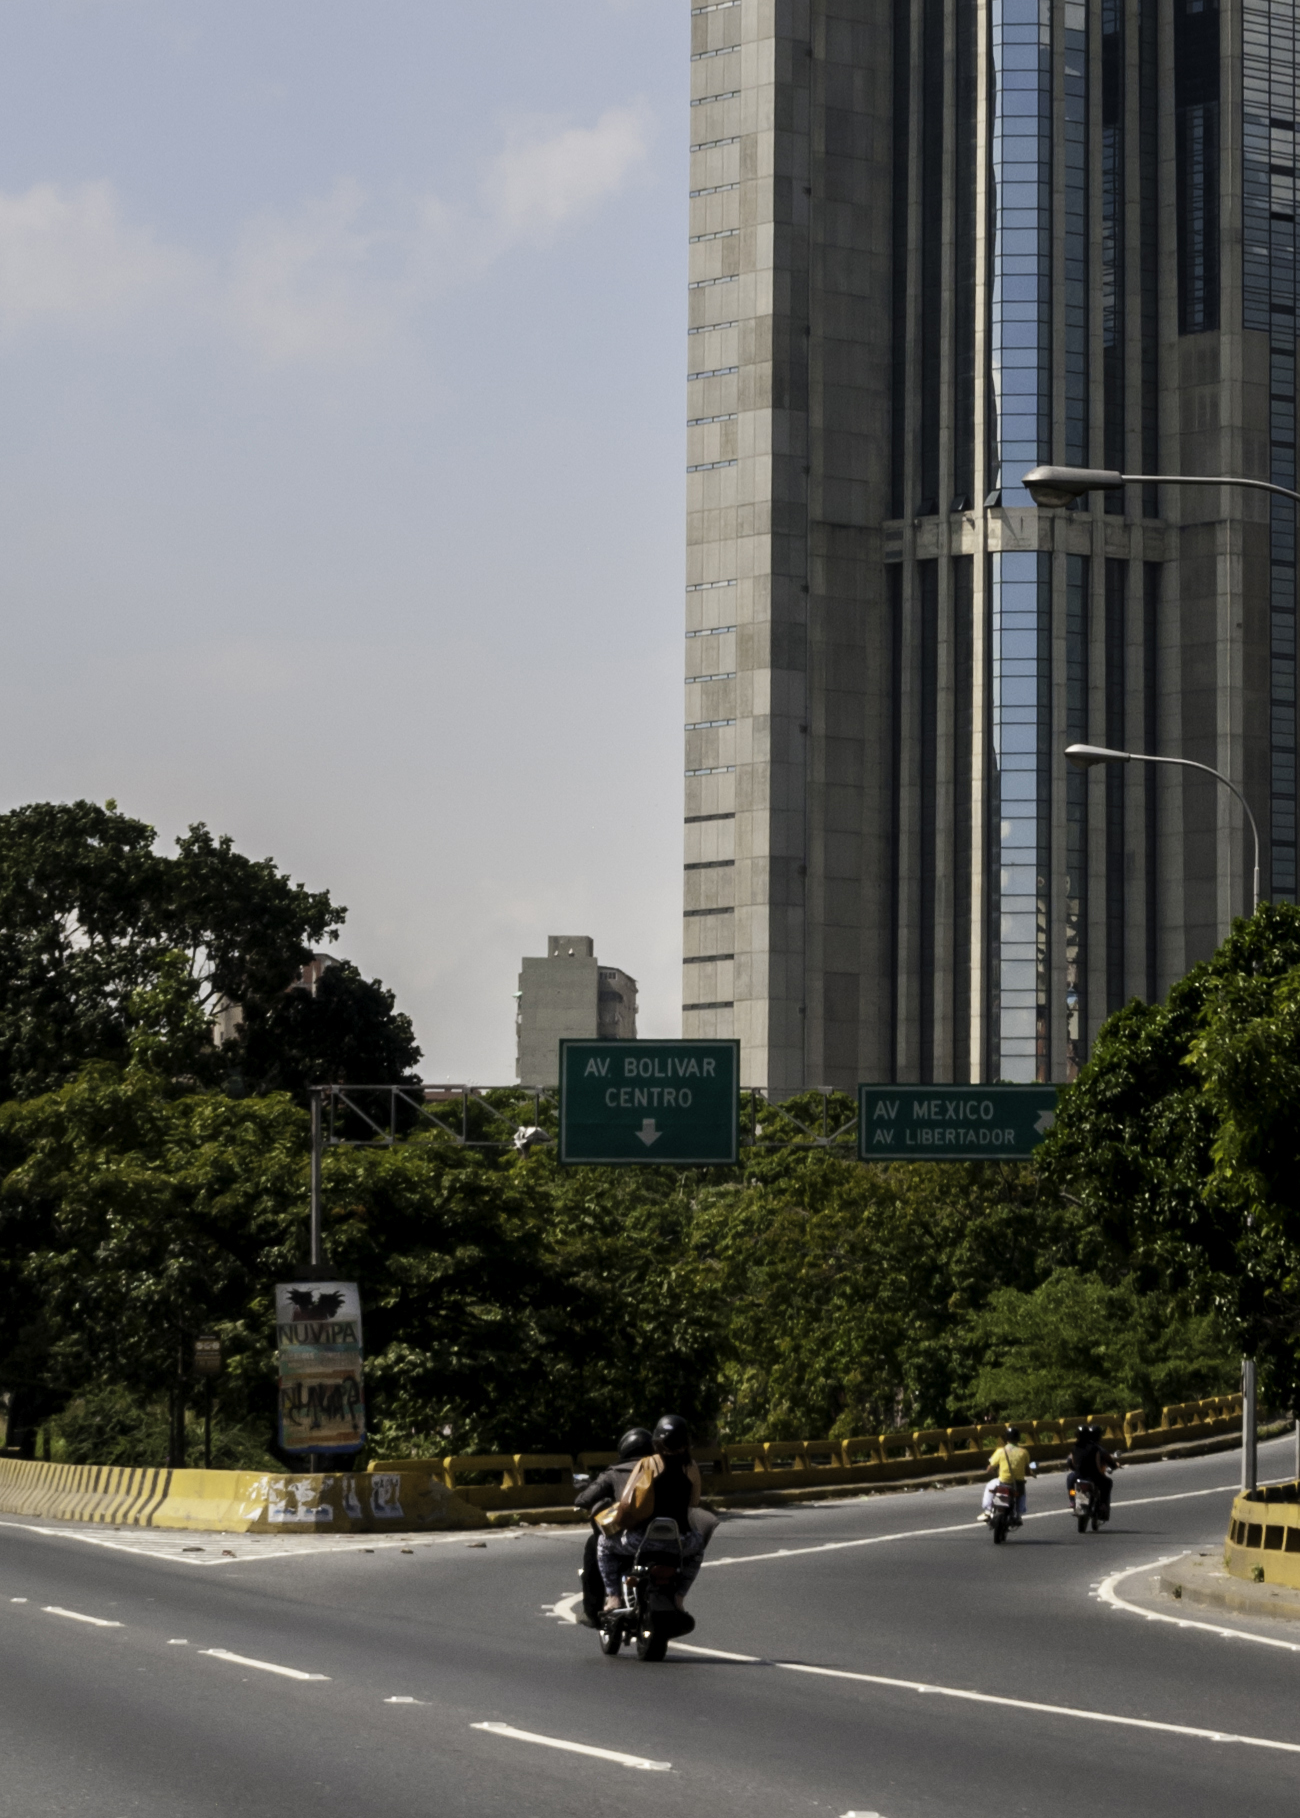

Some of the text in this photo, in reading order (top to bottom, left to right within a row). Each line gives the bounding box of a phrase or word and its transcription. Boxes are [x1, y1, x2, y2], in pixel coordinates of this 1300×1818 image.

[584, 1057, 716, 1077] AV. BOLIVAR
[605, 1088, 692, 1107] CENTRO
[912, 1100, 994, 1120] MEXICO
[906, 1128, 1015, 1145] LIBERTADOR
